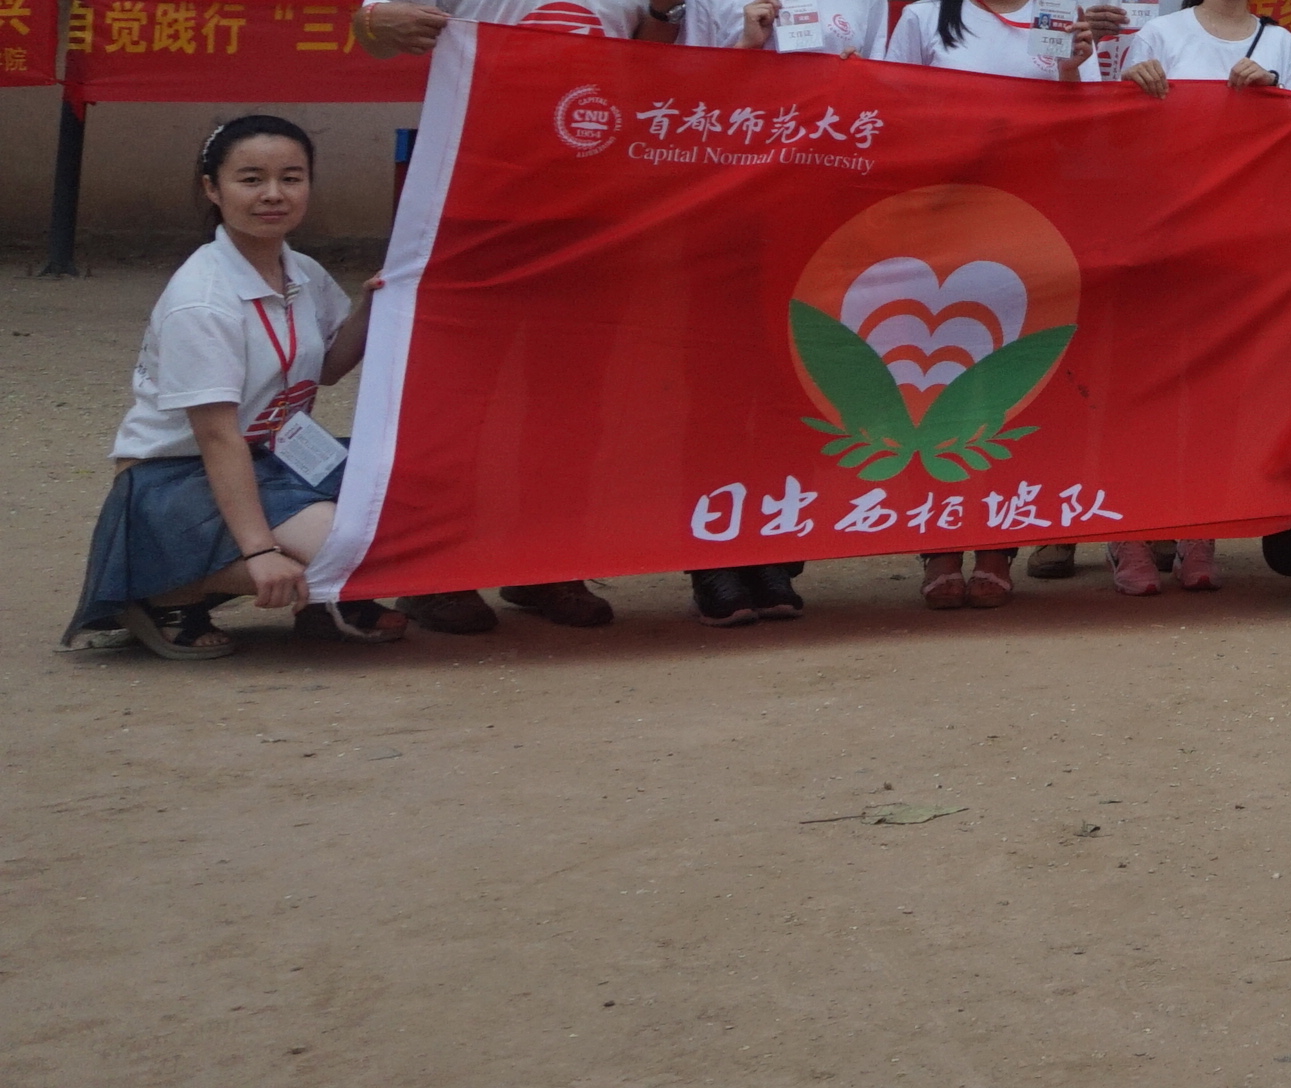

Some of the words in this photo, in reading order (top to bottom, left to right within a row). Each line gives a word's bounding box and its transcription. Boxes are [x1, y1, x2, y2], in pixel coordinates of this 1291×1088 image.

[572, 109, 610, 123] CNU
[636, 98, 885, 150] 首都师范大学
[628, 141, 697, 167] Capital
[703, 146, 775, 166] Normal
[779, 148, 876, 176] University
[690, 475, 1124, 542] 日出西柏坡队
